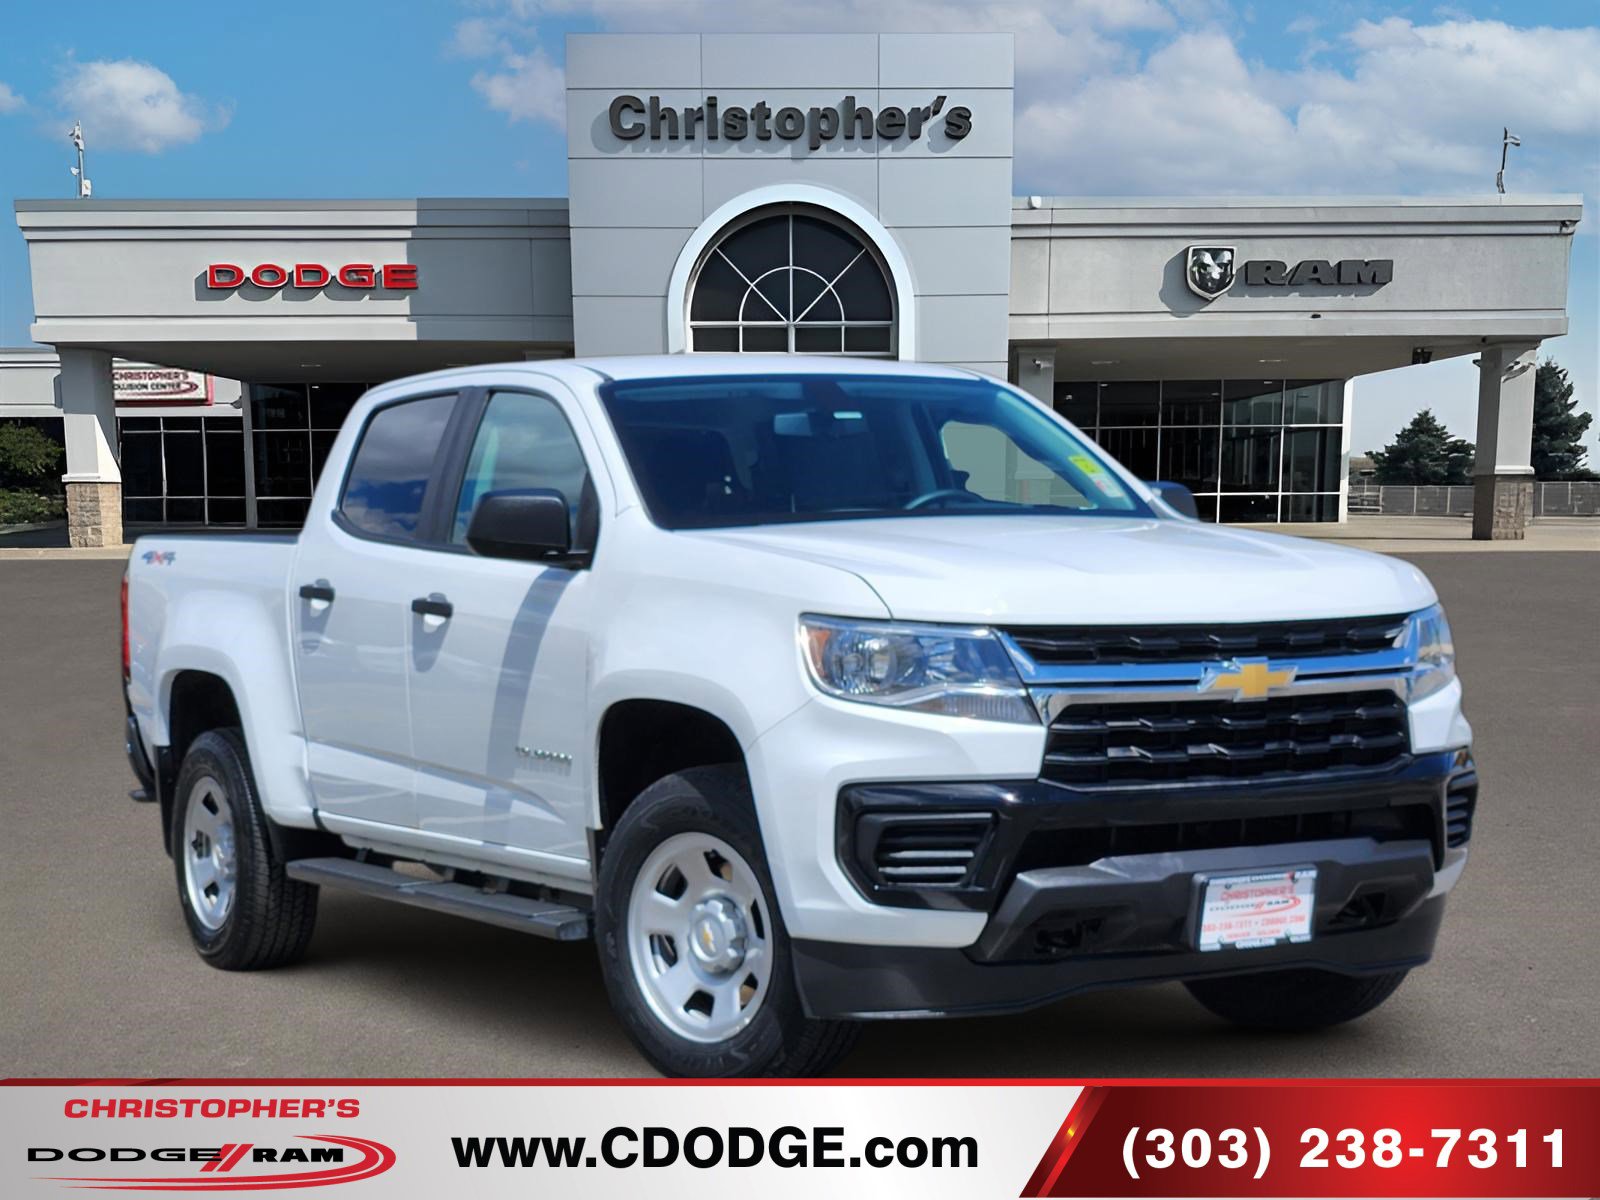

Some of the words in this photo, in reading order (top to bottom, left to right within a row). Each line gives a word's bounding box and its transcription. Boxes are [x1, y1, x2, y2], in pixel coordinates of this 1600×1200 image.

[608, 95, 972, 150] Christopher's
[207, 263, 418, 289] DODGE
[1246, 260, 1393, 286] RAM
[113, 382, 149, 391] OLLISION
[150, 382, 182, 391] CENTER
